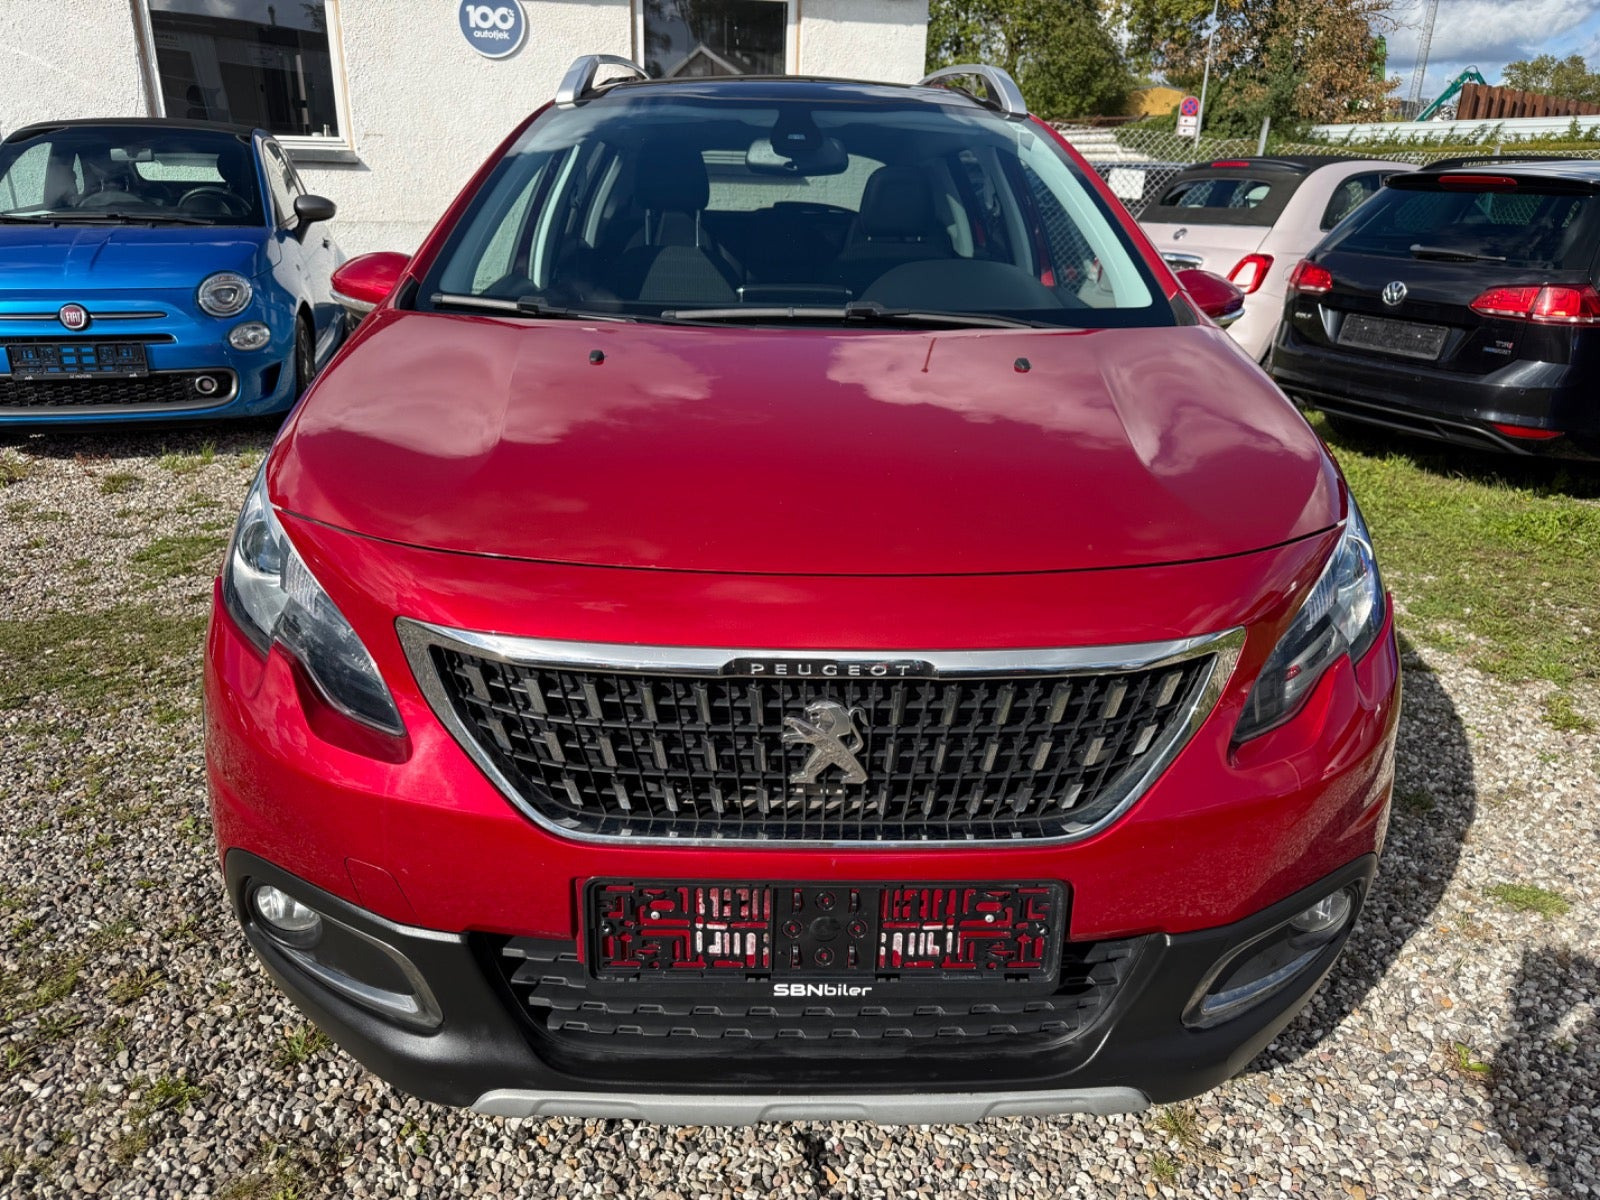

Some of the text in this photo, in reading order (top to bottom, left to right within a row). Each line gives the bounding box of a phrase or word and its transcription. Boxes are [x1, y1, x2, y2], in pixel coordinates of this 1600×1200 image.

[473, 30, 510, 40] autotjek
[65, 311, 81, 323] FIAT
[750, 663, 910, 676] PEUGEOT
[773, 983, 873, 996] SBNbiler
